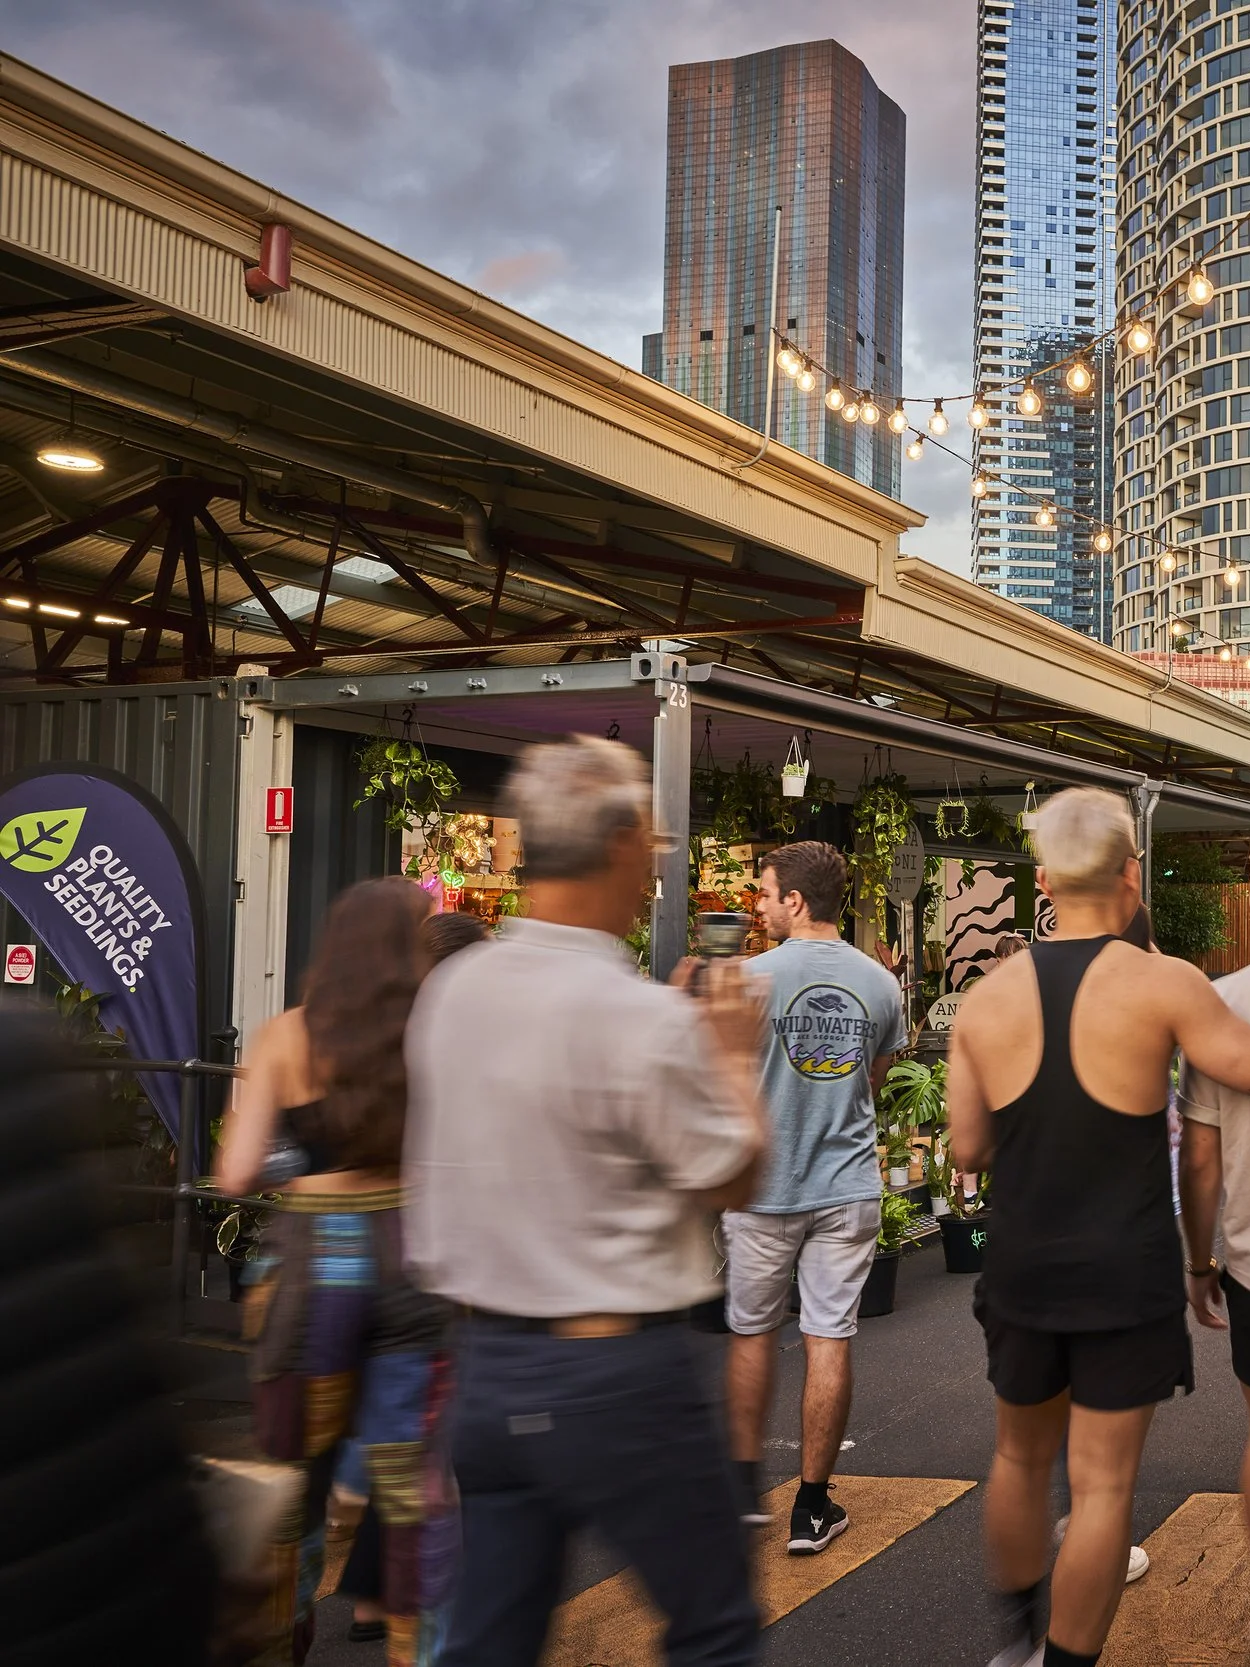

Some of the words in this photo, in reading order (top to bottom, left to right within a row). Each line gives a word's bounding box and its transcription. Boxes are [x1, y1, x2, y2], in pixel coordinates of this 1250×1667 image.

[670, 682, 687, 708] 23
[65, 857, 140, 938] PLANTS
[131, 936, 153, 961] &
[89, 844, 173, 932] QUALITY
[772, 1016, 813, 1034] WILD
[816, 1016, 878, 1039] WATERS
